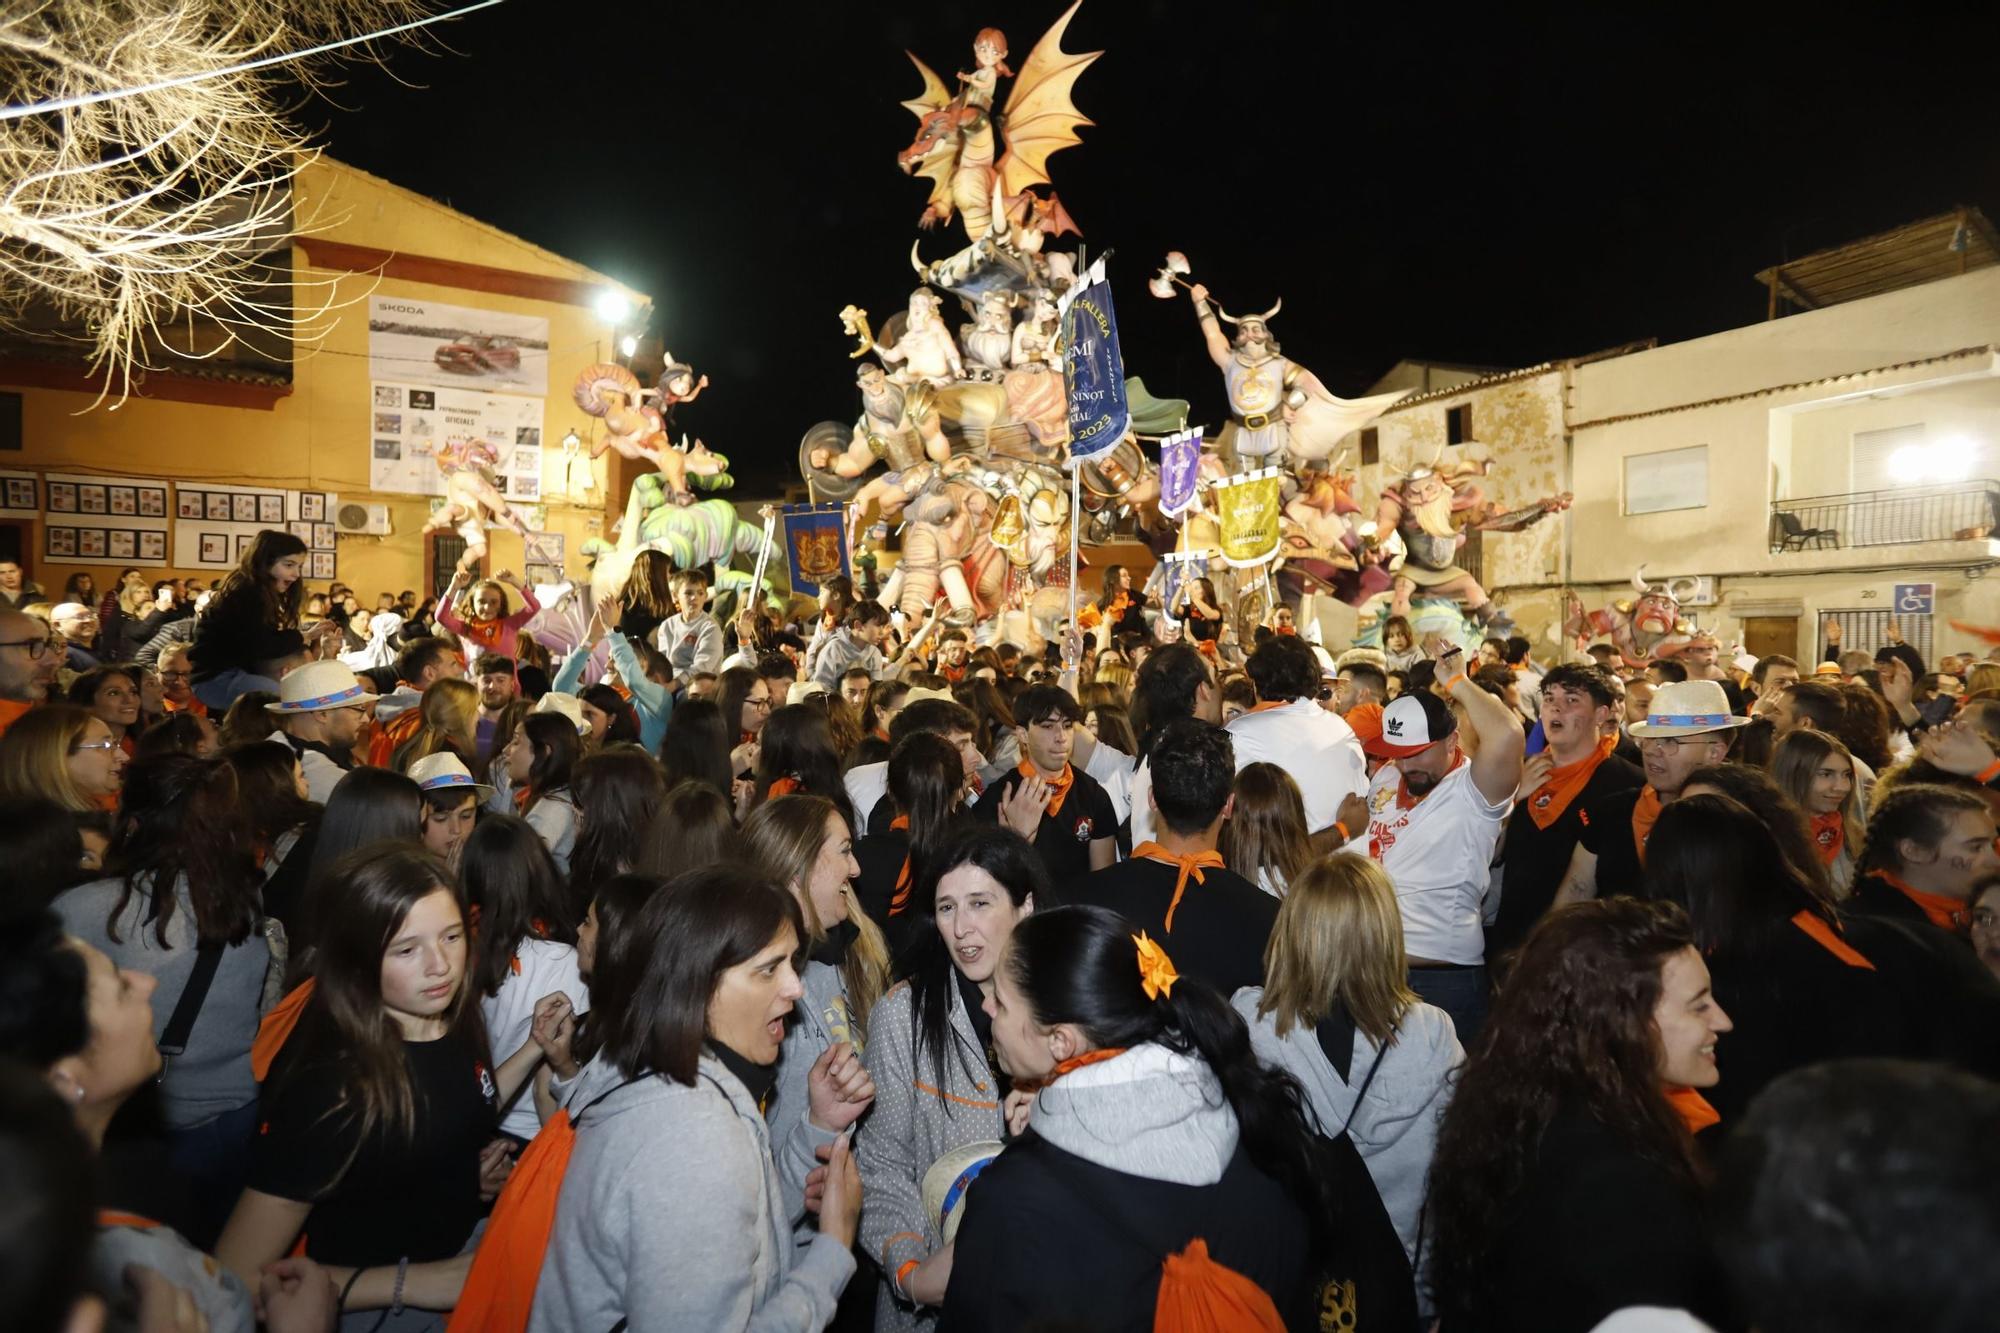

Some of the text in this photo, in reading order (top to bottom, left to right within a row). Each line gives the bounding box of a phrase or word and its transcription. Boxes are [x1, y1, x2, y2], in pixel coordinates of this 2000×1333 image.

[1081, 299, 1110, 338] FALLERA
[1107, 348, 1118, 403] INFANTILS
[1072, 390, 1105, 401] NINOT
[1079, 414, 1111, 440] 2023
[1861, 590, 1877, 599] 20
[1387, 730, 1403, 738] adidas
